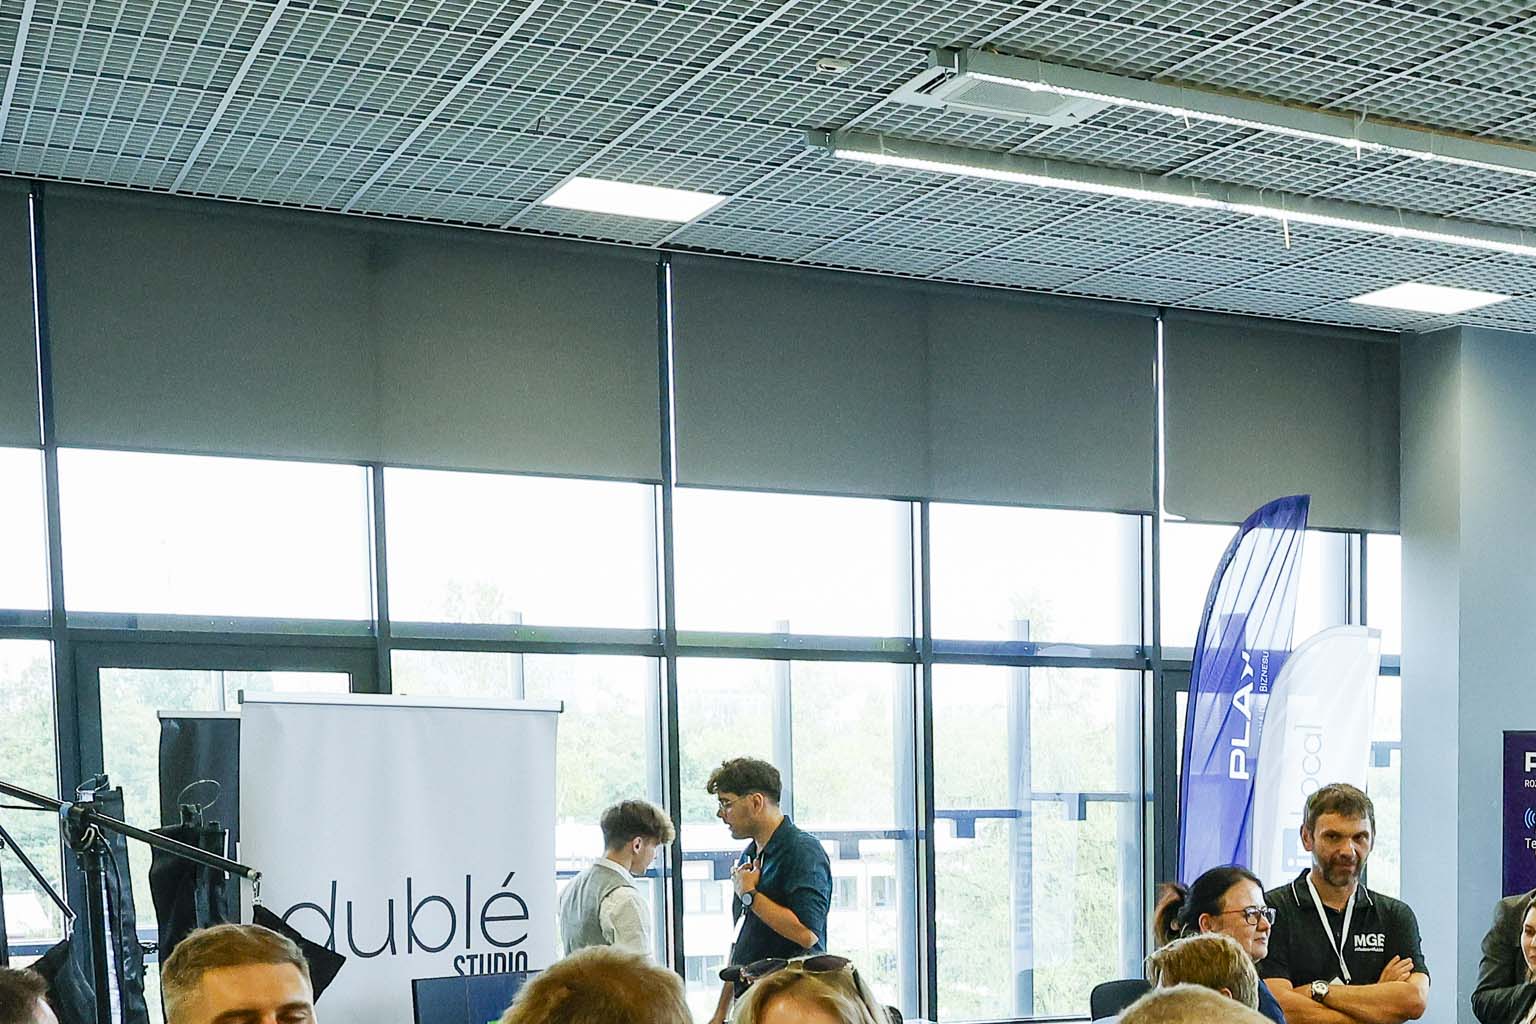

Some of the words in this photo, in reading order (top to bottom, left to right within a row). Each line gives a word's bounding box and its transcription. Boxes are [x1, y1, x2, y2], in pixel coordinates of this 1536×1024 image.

[1259, 651, 1270, 692] BIZNESU
[1229, 650, 1254, 780] PLAY
[281, 871, 529, 958] dublé
[1354, 933, 1385, 947] MGE
[453, 950, 528, 977] STUDIO
